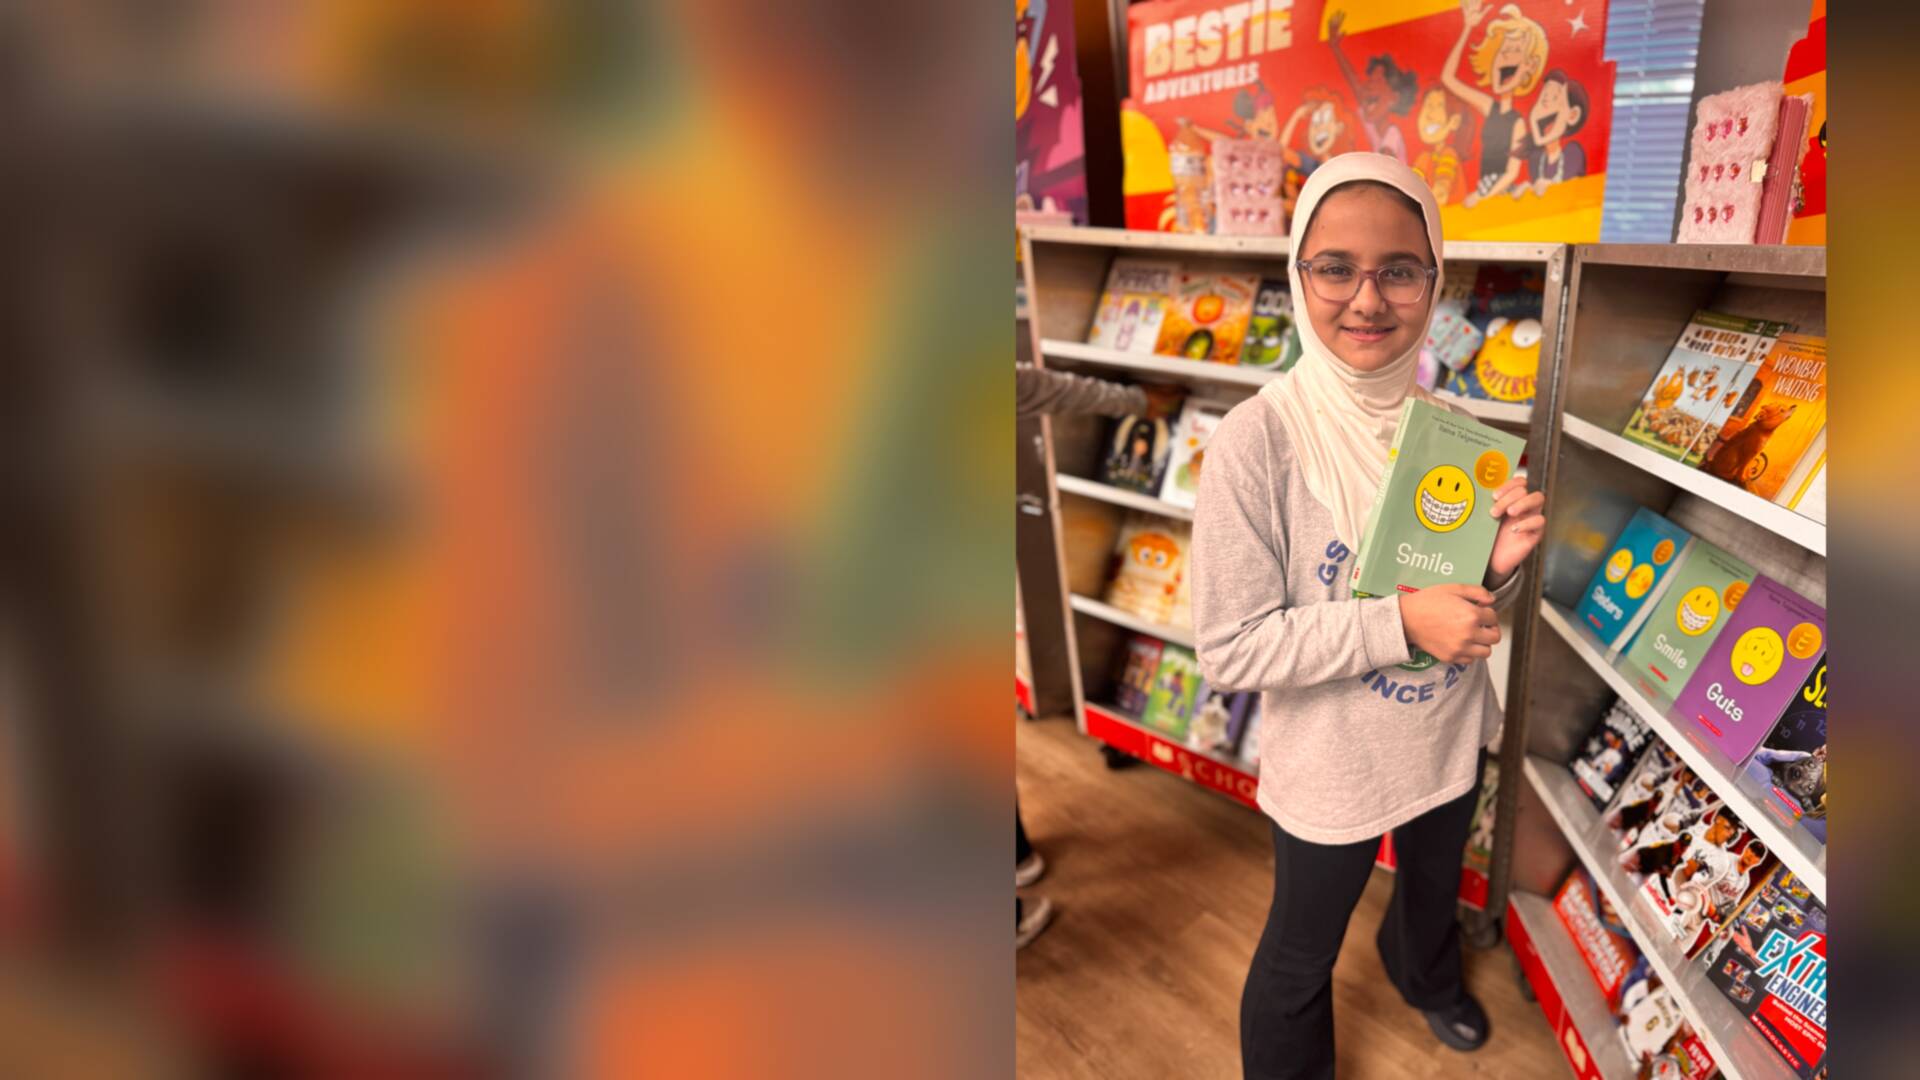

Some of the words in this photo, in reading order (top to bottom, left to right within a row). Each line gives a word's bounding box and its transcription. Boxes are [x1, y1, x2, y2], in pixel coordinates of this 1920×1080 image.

[1144, 0, 1294, 78] BESTIE
[1143, 62, 1260, 104] ADVENTURES
[1773, 353, 1826, 380] WOMBAT
[1773, 376, 1823, 402] WAITING
[1396, 543, 1454, 575] Smile
[1592, 585, 1623, 620] Sisters
[1653, 633, 1688, 669] Smile
[1361, 669, 1436, 703] INCE
[1706, 682, 1744, 722] Guts
